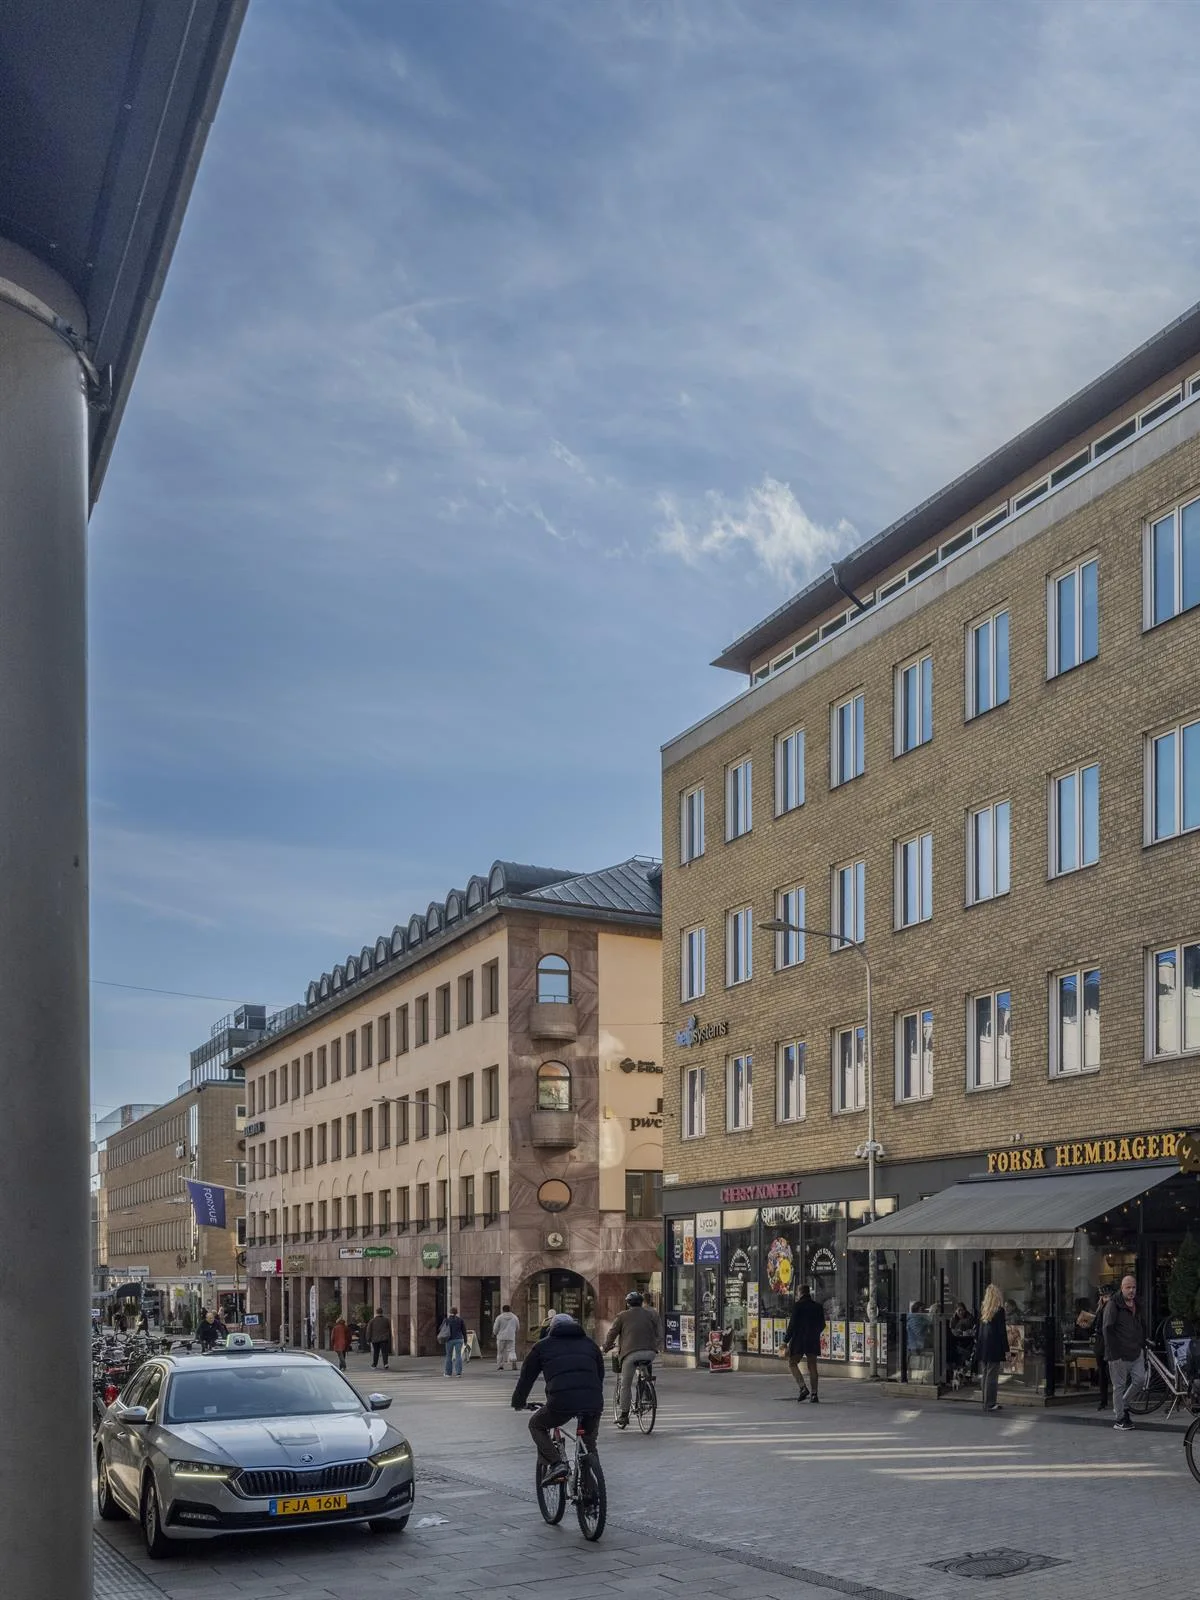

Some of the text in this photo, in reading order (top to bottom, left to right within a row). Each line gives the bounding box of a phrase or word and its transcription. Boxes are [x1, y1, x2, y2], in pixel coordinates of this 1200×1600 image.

[630, 1117, 663, 1131] pwc
[986, 1131, 1186, 1174] FORSA HEMBAGER
[203, 1187, 217, 1224] FORMUE
[282, 1496, 342, 1513] FJA 16N
